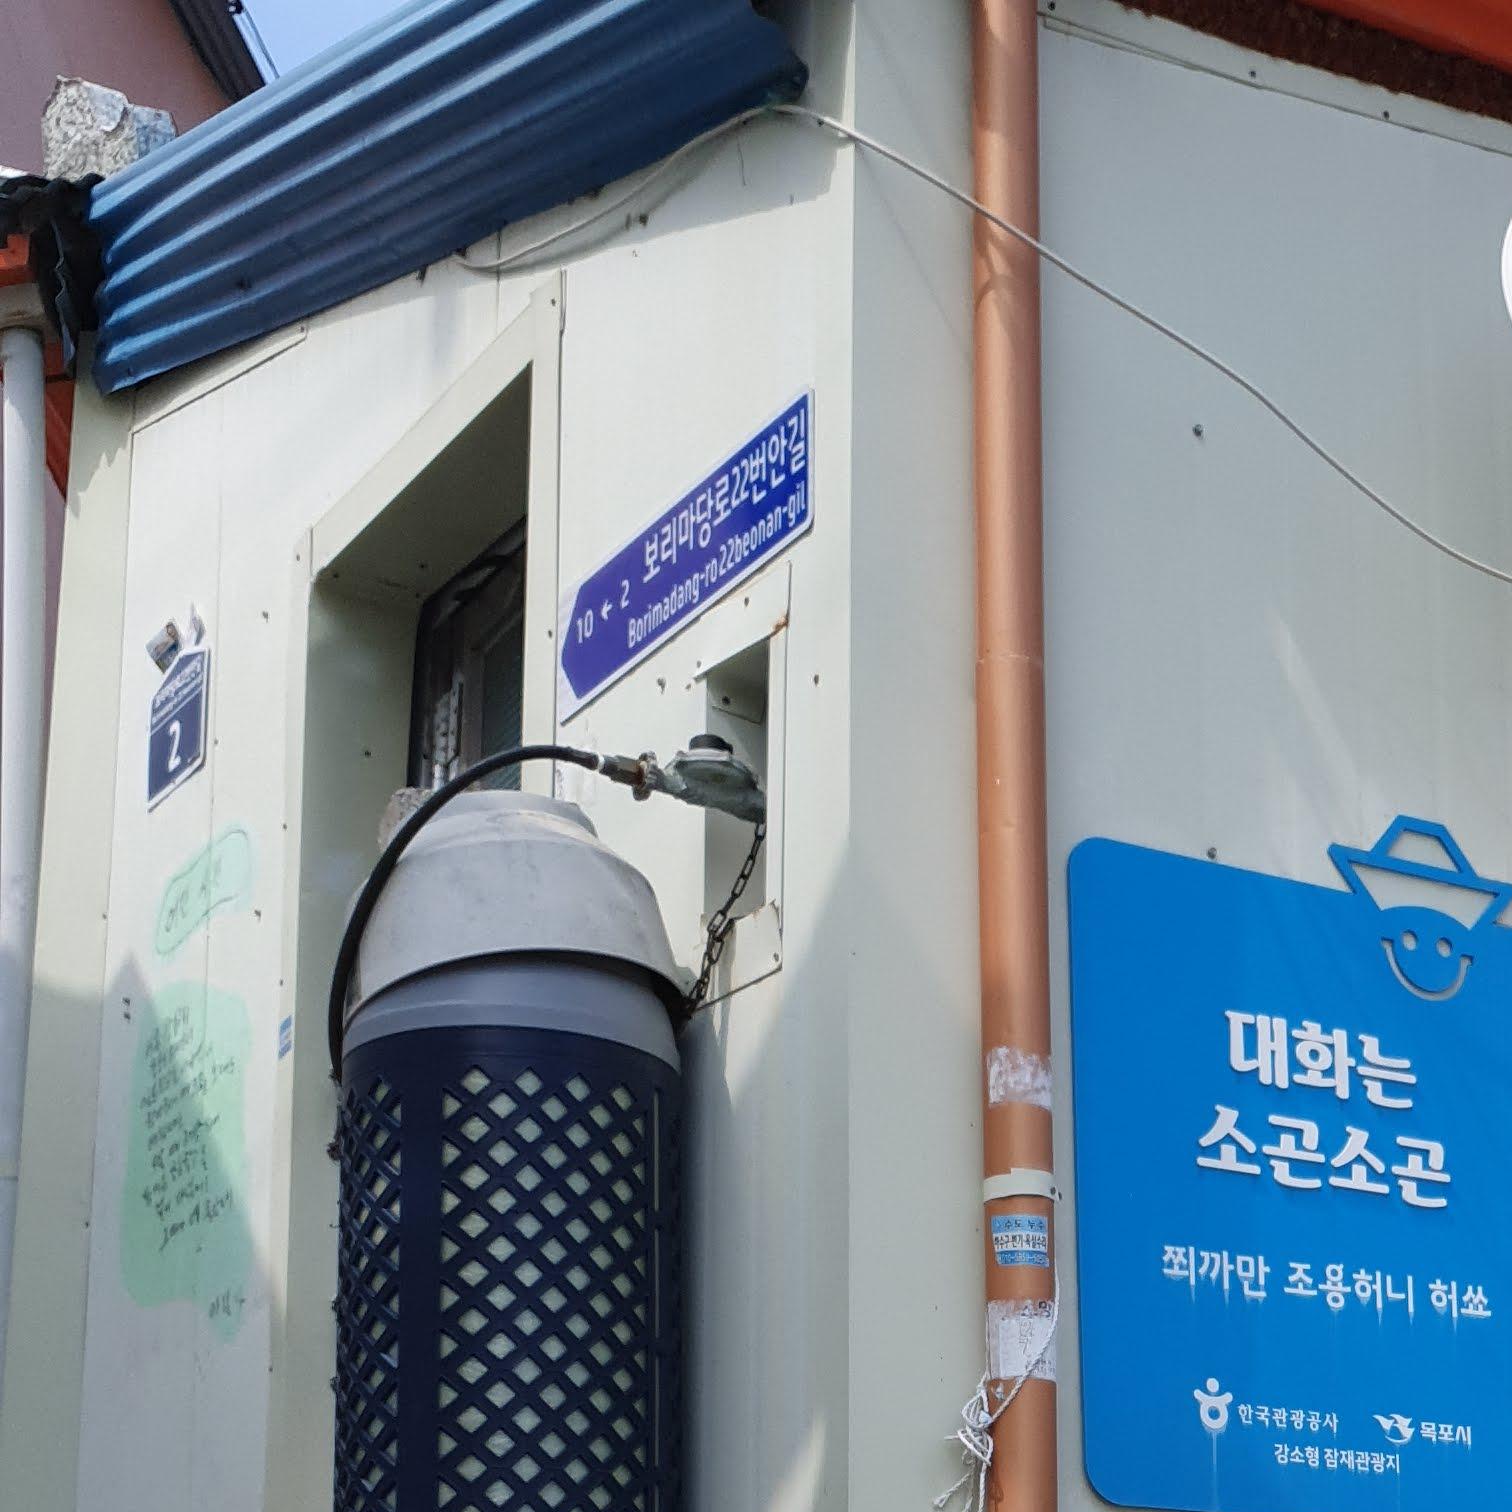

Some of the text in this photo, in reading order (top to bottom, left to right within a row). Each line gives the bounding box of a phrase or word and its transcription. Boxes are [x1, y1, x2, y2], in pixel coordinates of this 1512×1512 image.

[576, 408, 805, 643] 10 2 보리마당로22번안길
[628, 480, 806, 648] Borimadang-ro 22beonan-gil
[168, 720, 181, 772] 2
[1225, 1010, 1418, 1108] 대화는
[1197, 1105, 1452, 1208] 소곤소곤
[1162, 1245, 1271, 1299] 쬐까만
[1284, 1262, 1414, 1314] 조용허니
[1238, 1403, 1339, 1433] 한국관광공사
[1420, 1421, 1472, 1446] 목포시
[1274, 1443, 1401, 1474] 강소형 잠재관광지
